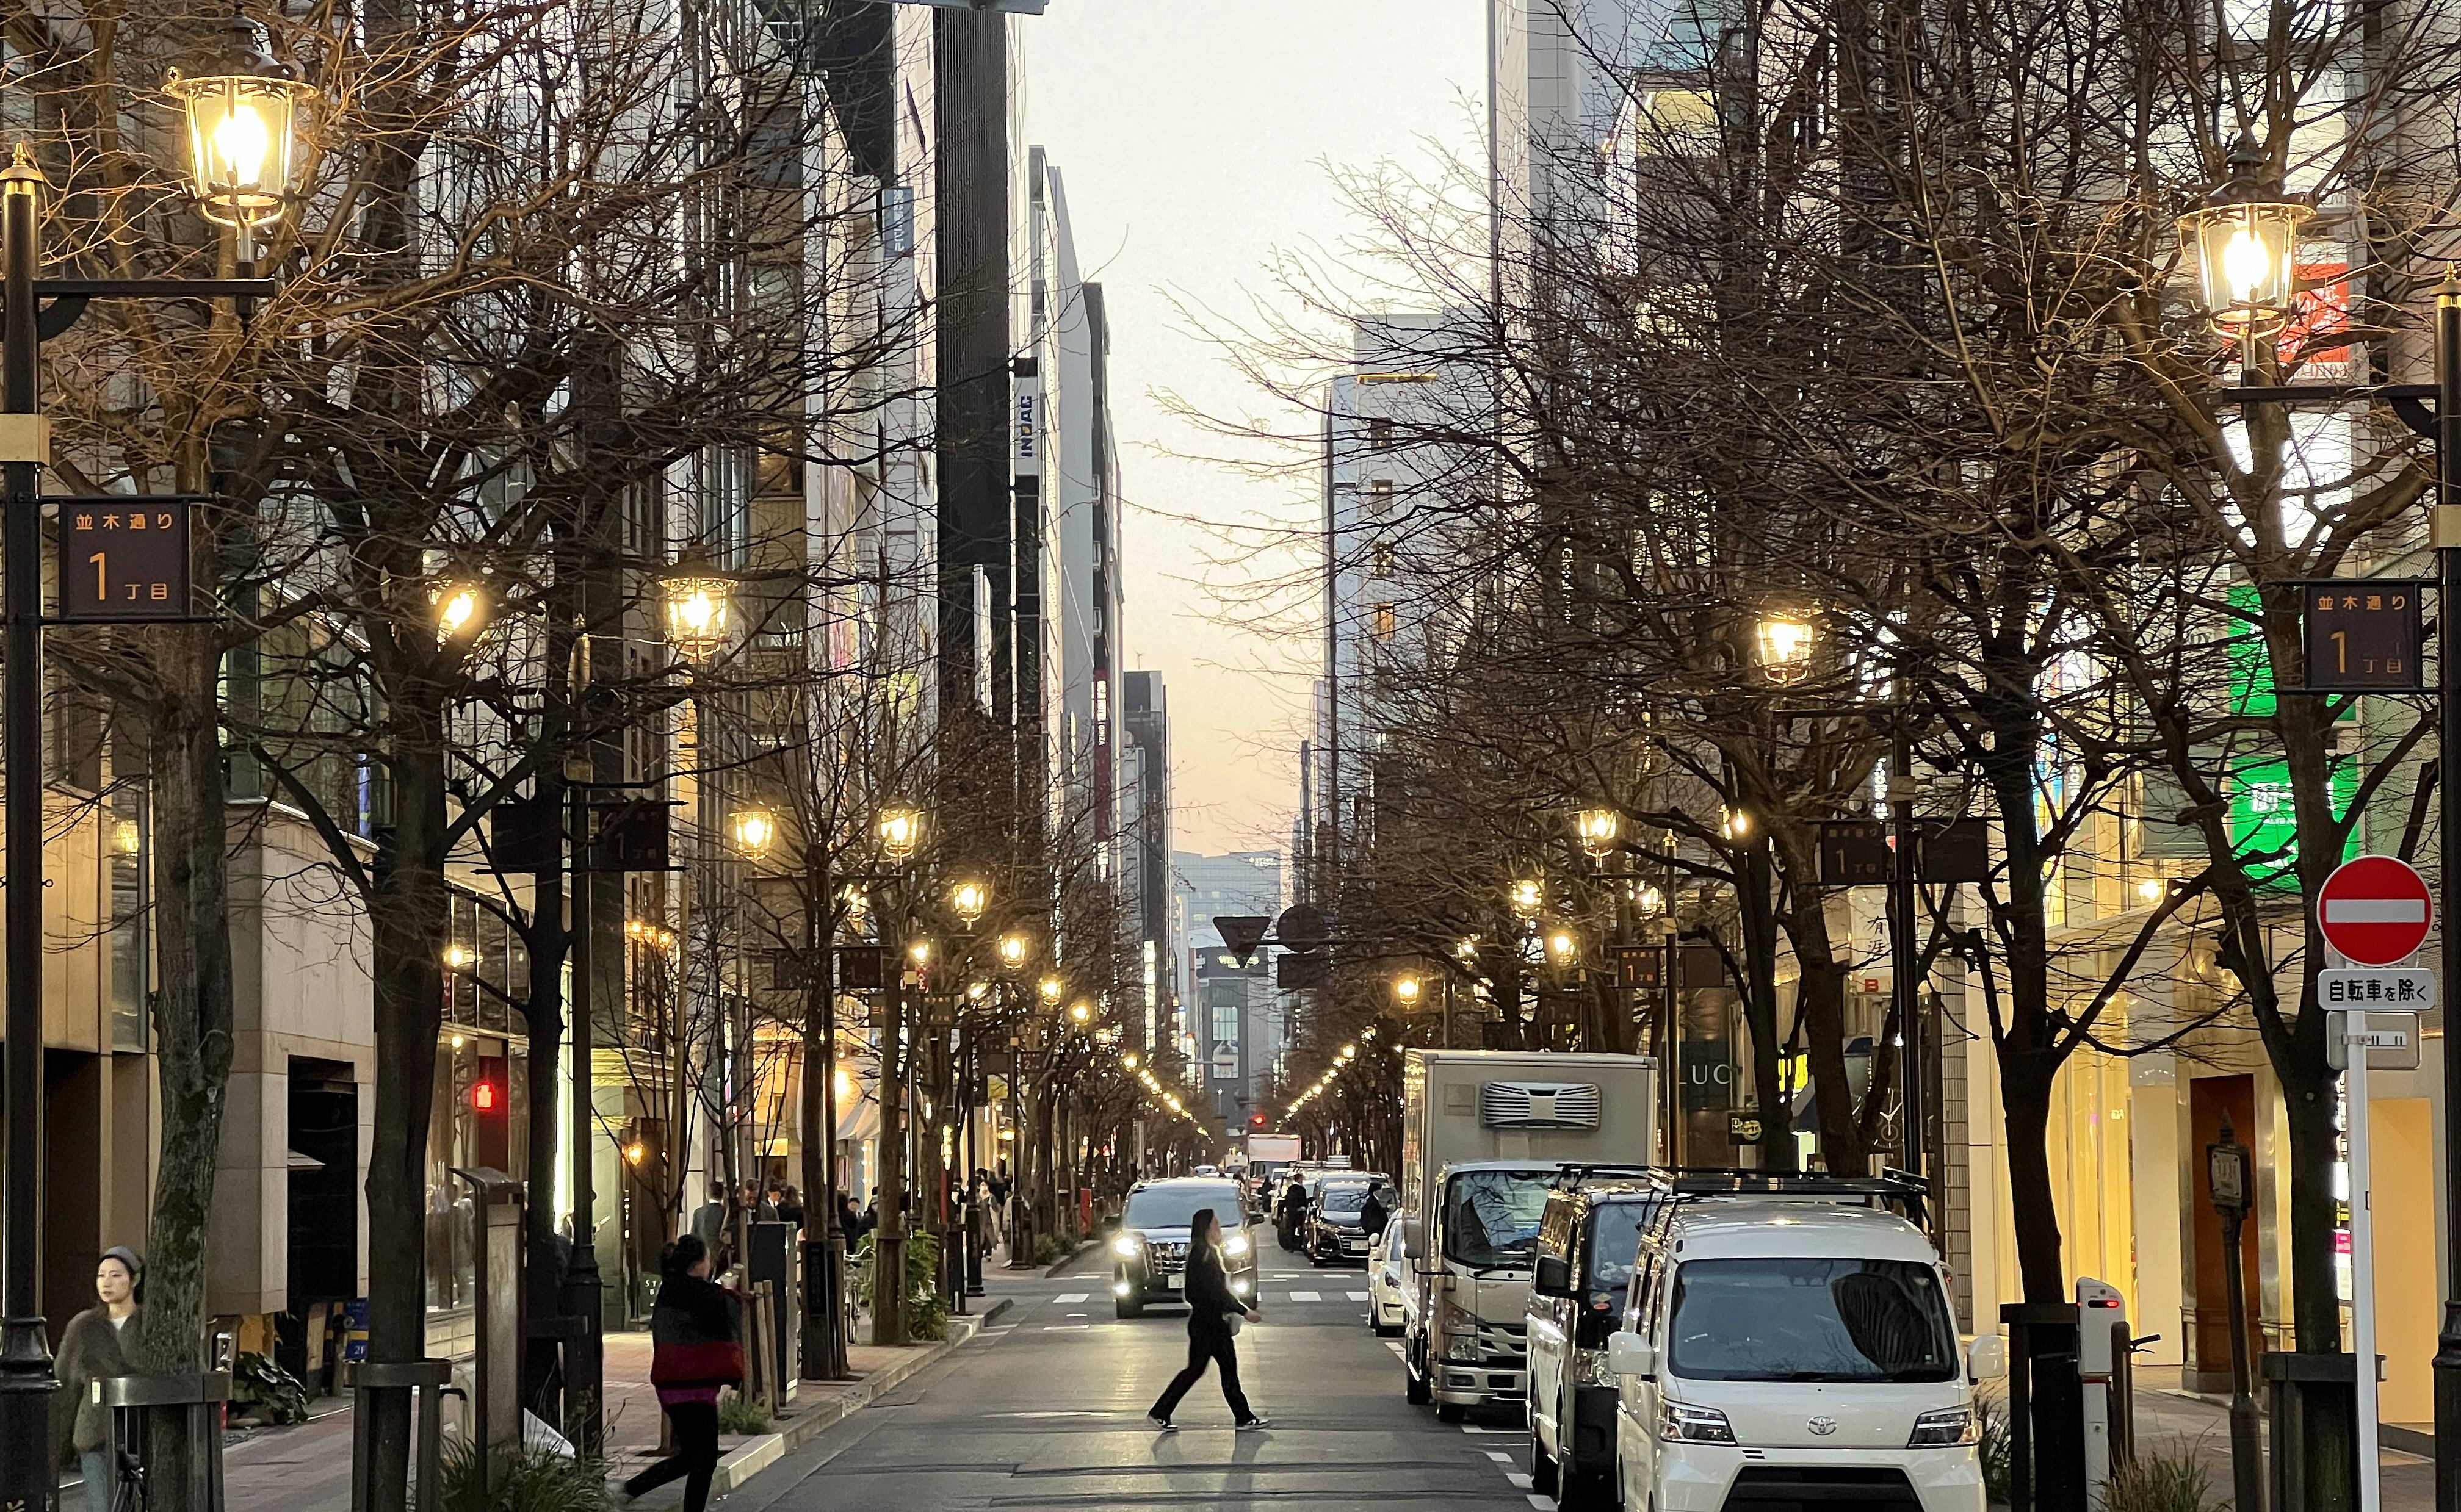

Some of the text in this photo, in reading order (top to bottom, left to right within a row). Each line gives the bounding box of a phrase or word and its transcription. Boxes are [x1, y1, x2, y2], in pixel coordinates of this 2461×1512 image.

[76, 514, 173, 530] 並木通り
[2318, 596, 2405, 610] 並木通り
[2330, 979, 2426, 1001] 自転車を除く
